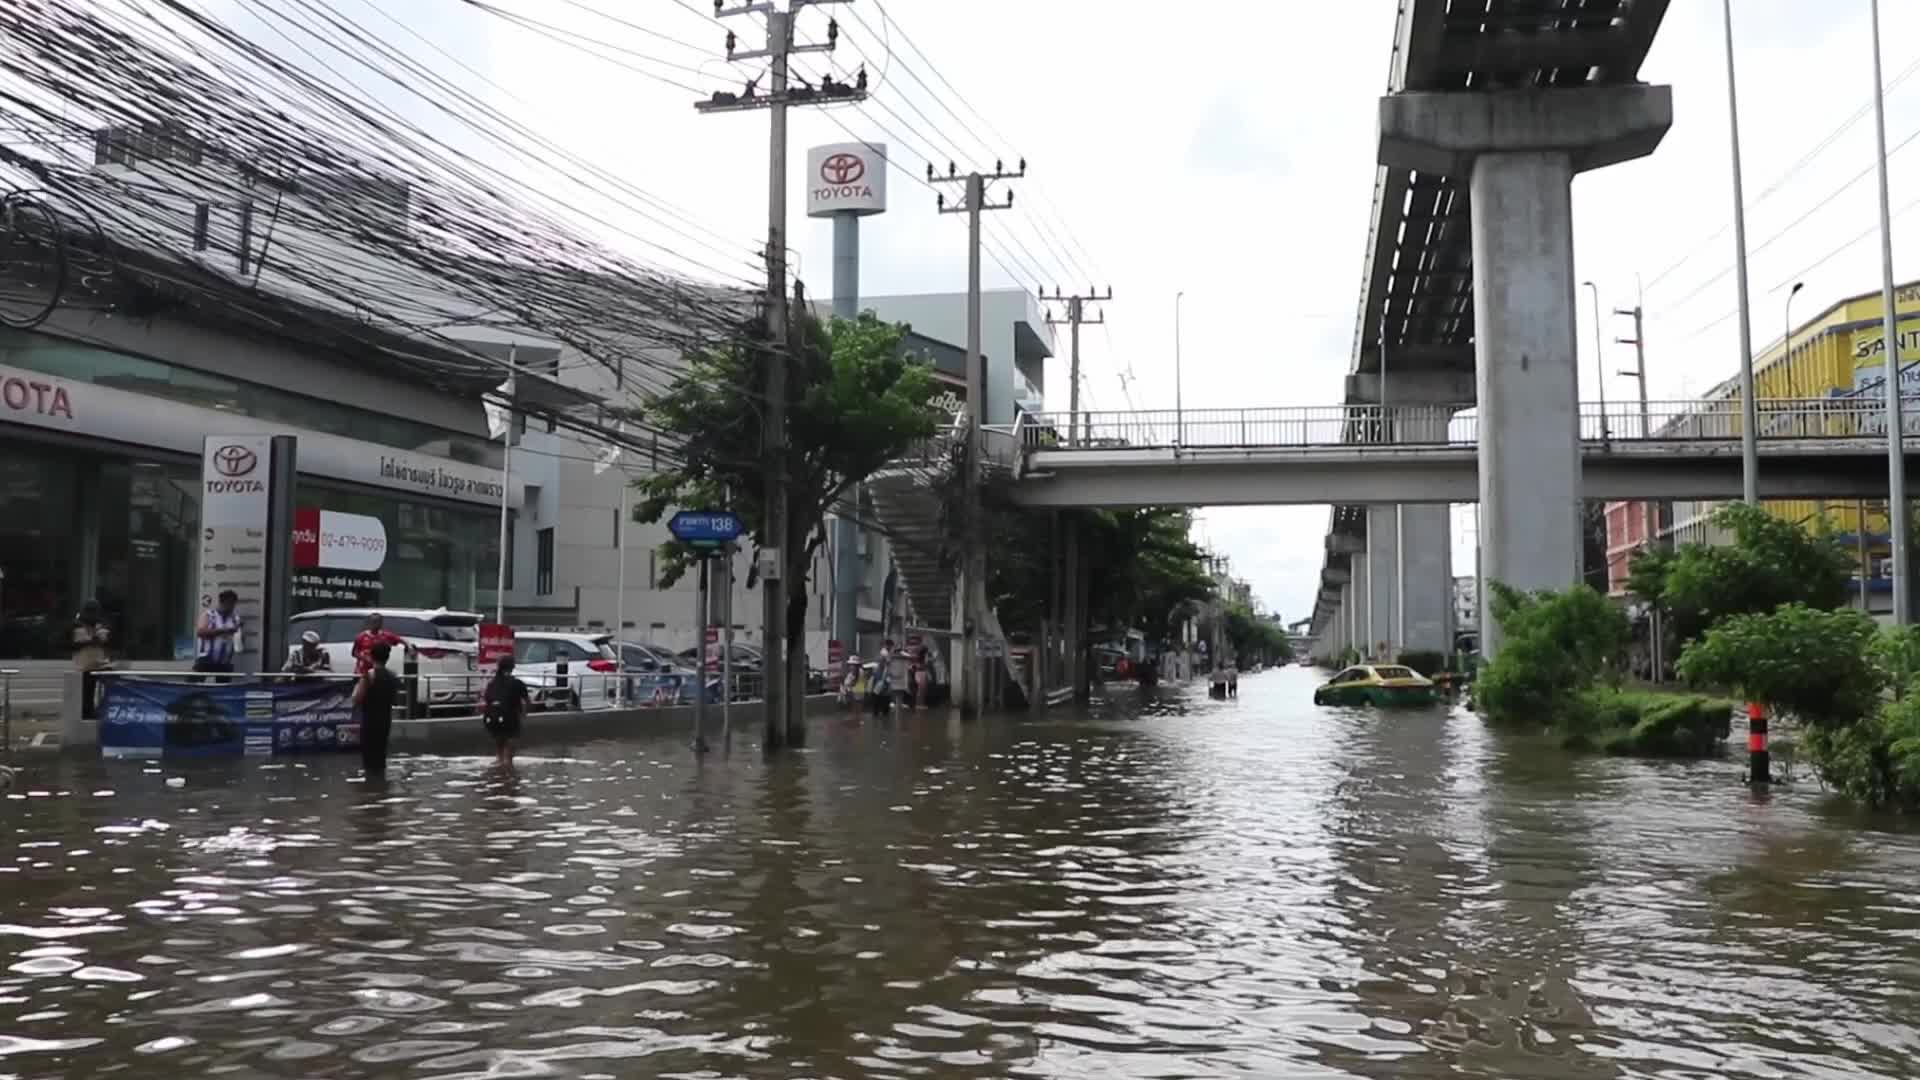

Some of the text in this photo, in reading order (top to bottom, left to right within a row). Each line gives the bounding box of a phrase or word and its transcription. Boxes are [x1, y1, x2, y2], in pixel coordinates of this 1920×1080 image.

[813, 185, 873, 201] TOYOTA
[0, 376, 73, 420] OTA
[206, 480, 264, 493] TOYOTA
[711, 517, 734, 532] 138
